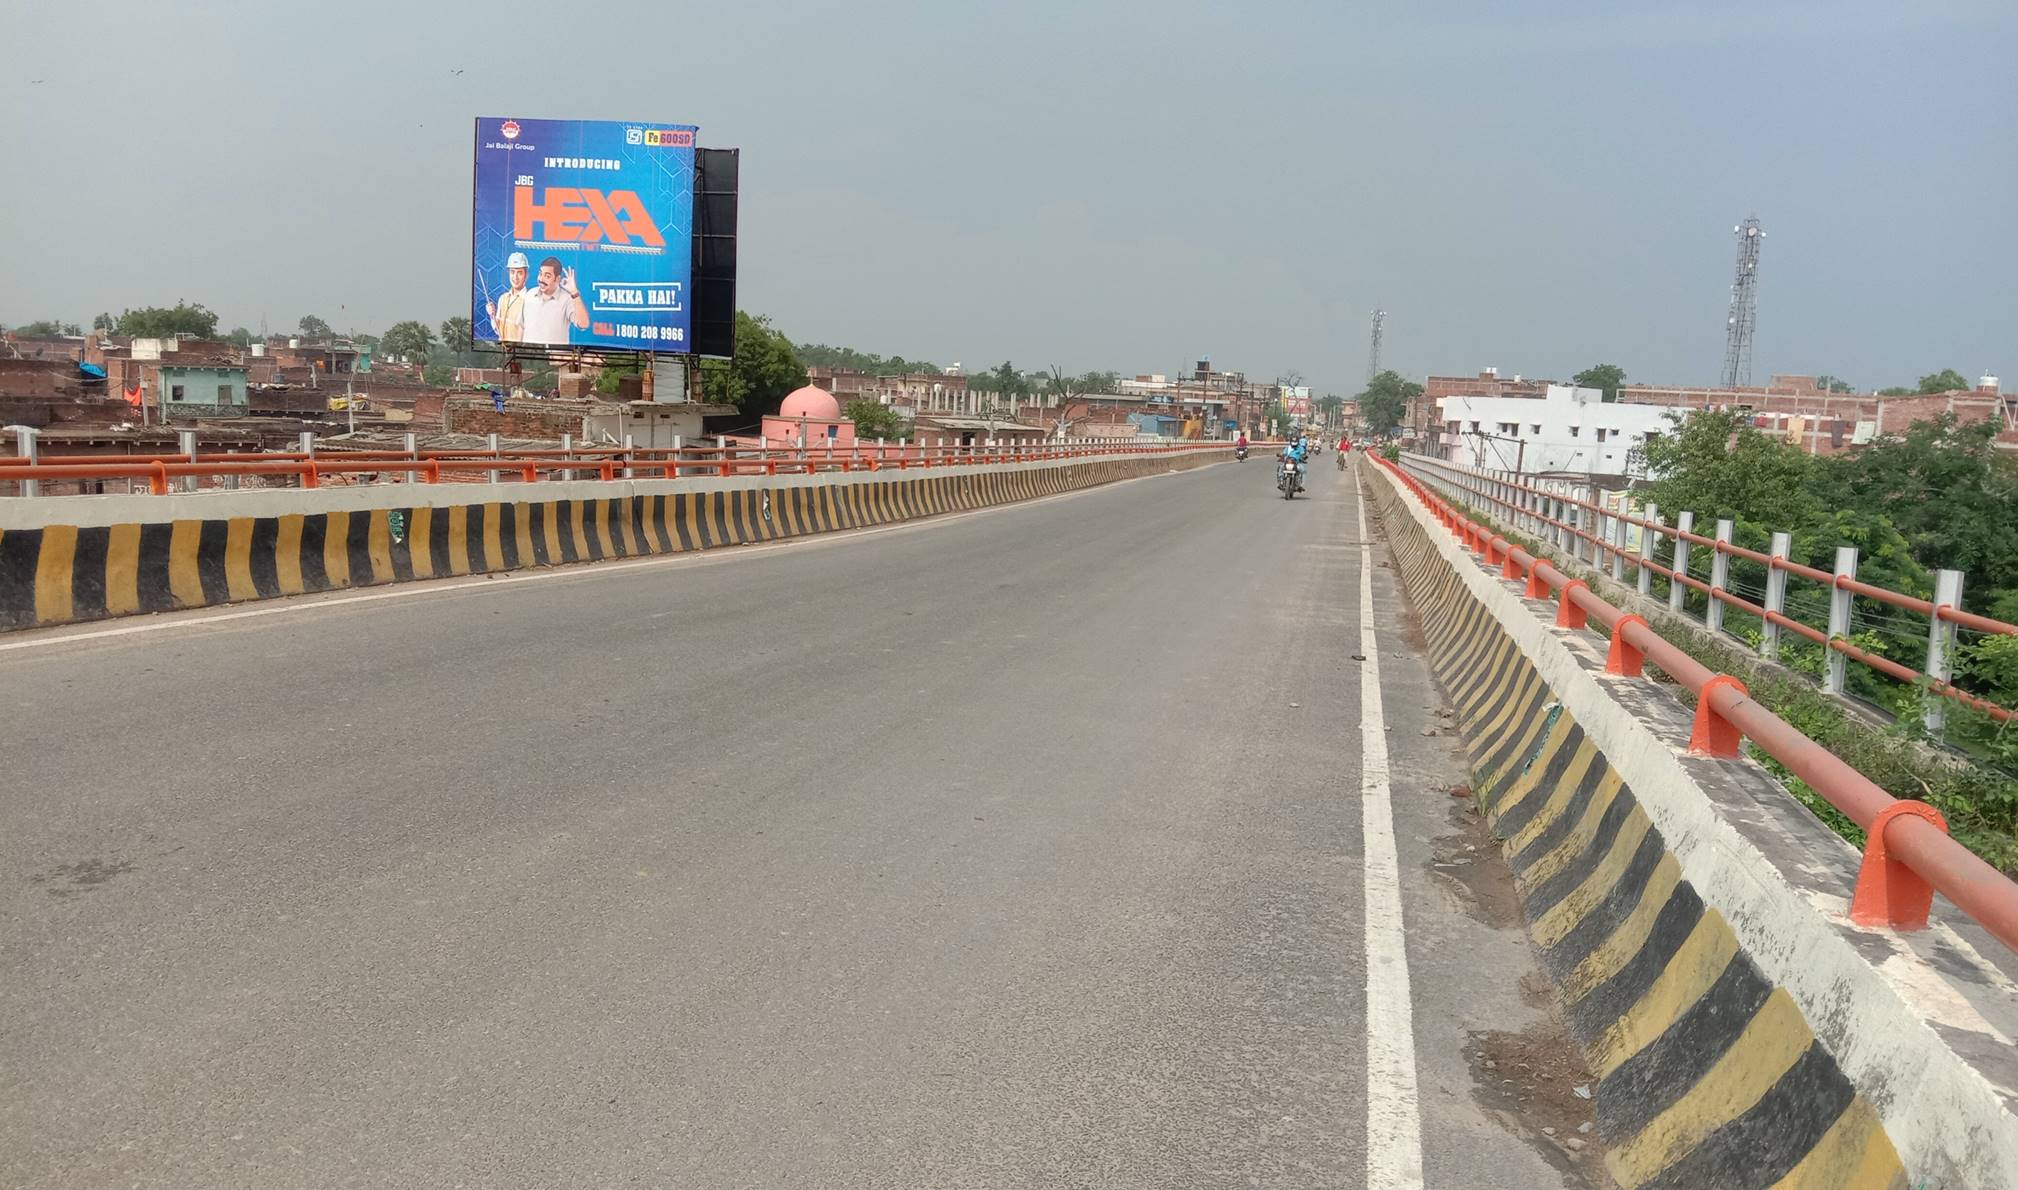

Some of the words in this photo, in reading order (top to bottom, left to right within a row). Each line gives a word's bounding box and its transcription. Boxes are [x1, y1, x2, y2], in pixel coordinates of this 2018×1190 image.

[514, 143, 535, 151] Group
[544, 157, 621, 170] INTRODUCING
[515, 175, 534, 186] JBG
[514, 185, 667, 247] HEXA
[599, 288, 643, 305] PAKKA
[648, 289, 676, 305] HAI!
[616, 324, 638, 339] 1800
[641, 326, 658, 340] 208
[660, 327, 684, 342] 9966
